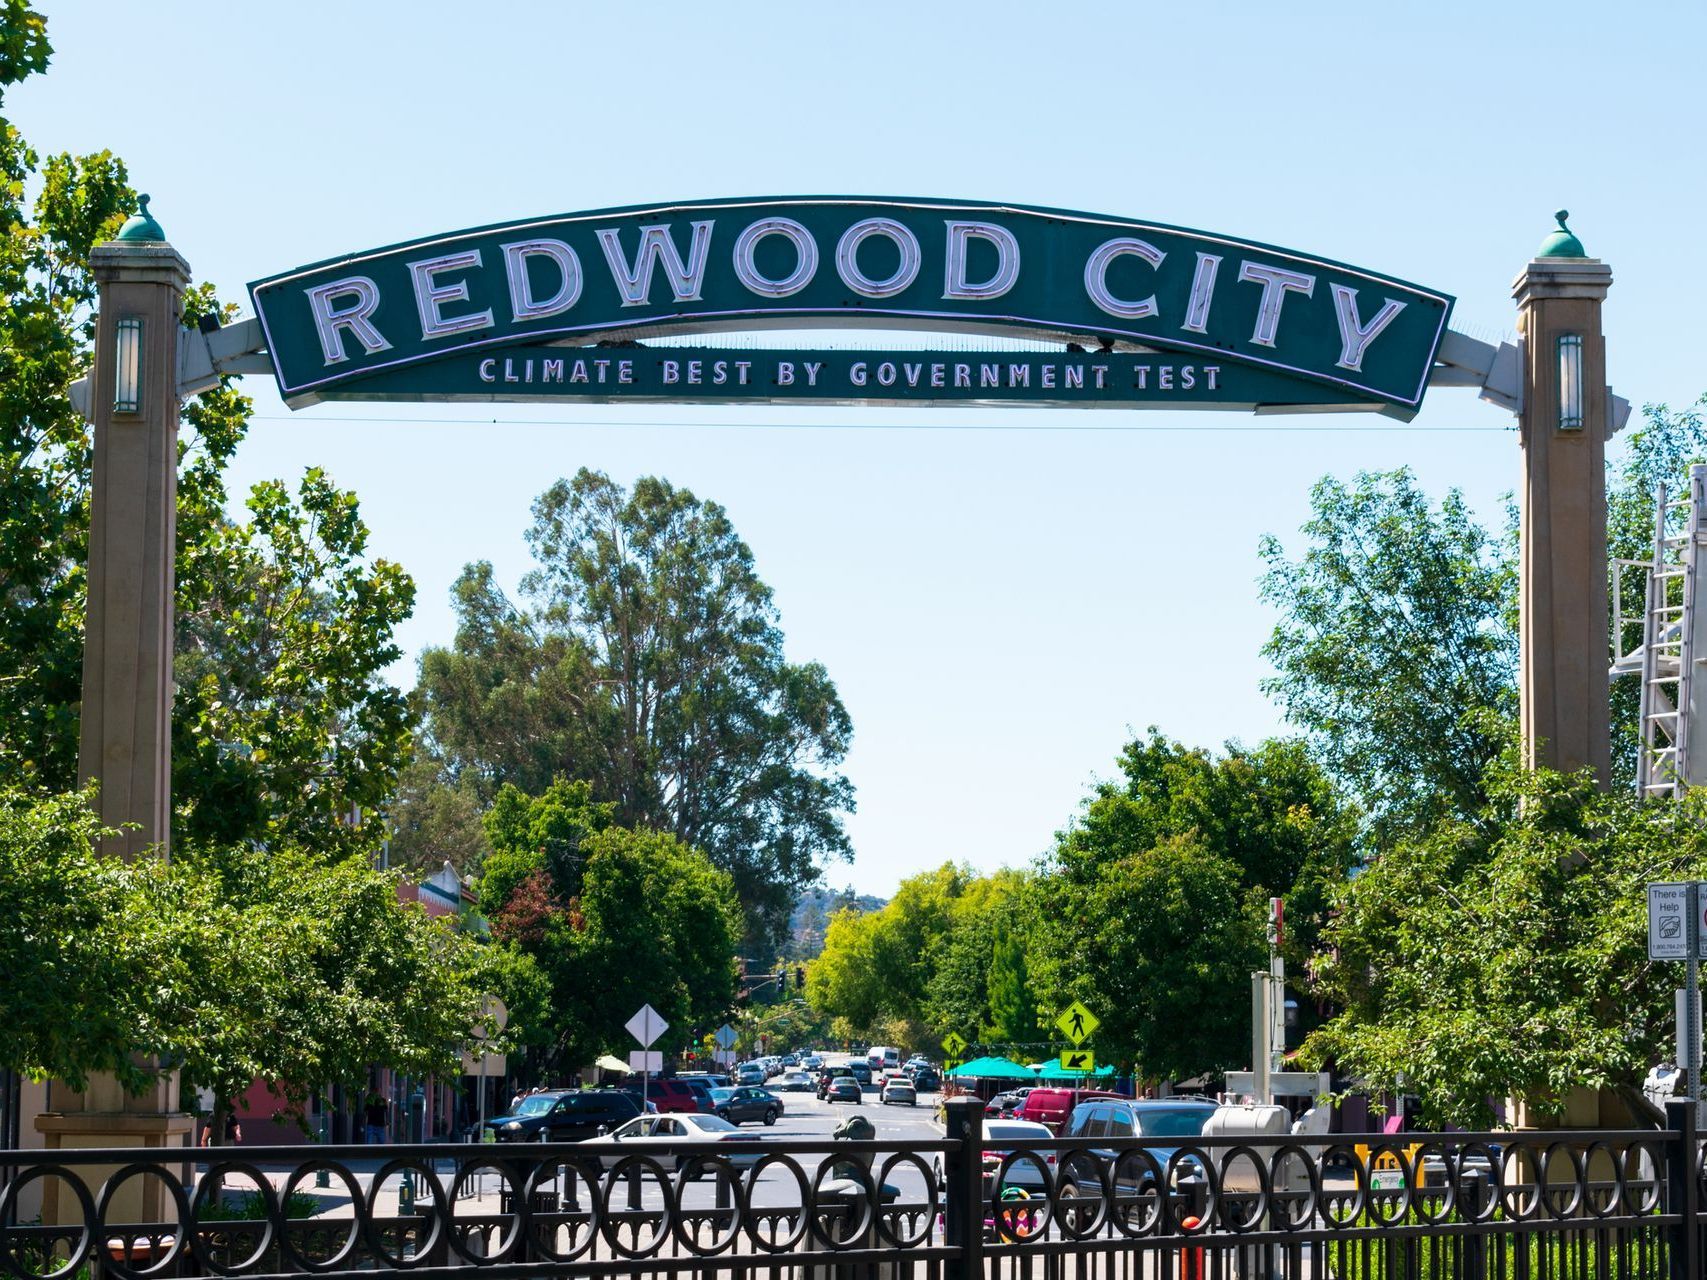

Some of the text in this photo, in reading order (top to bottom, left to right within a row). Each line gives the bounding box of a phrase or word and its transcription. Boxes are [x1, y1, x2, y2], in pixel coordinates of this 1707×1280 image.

[303, 216, 1408, 372] REDWOOD CITY
[479, 358, 1221, 390] CLIMATE BEST BY GOVERNMENT TEST
[1653, 890, 1686, 899] There is
[1659, 903, 1680, 912] Help
